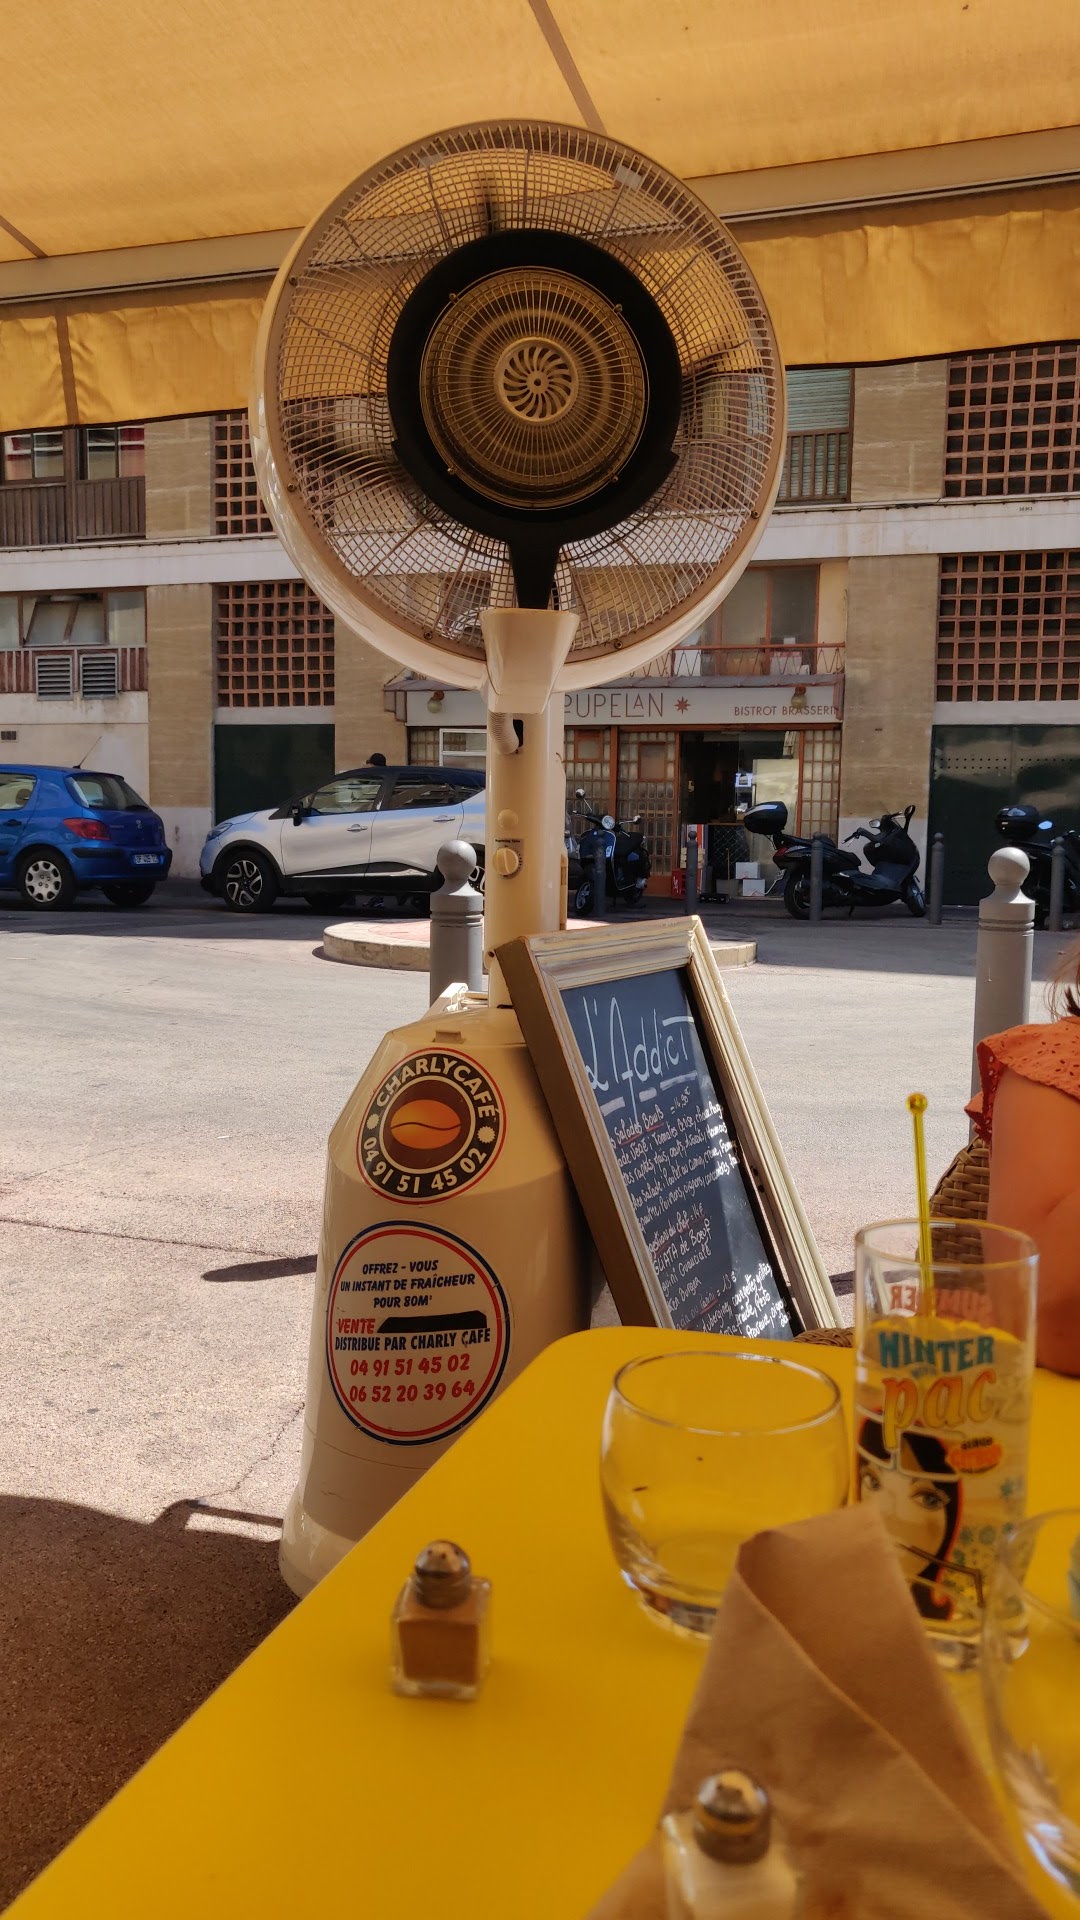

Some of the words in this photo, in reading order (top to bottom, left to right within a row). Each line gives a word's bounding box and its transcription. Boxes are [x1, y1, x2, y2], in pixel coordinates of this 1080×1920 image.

[734, 705, 777, 717] BISTROT
[781, 704, 840, 716] BRASSERI
[363, 1136, 380, 1162] 04
[372, 1161, 394, 1185] 91
[396, 1175, 420, 1194] 51
[431, 1168, 458, 1191] 45
[459, 1147, 487, 1174] 02
[362, 1262, 399, 1275] OFFREZ
[409, 1260, 439, 1273] VOUS
[340, 1281, 351, 1291] UN
[352, 1280, 392, 1292] INSTANT
[393, 1279, 407, 1290] DE
[410, 1273, 475, 1290] FRAÎCHEUR
[373, 1297, 401, 1308] POUR
[337, 1318, 376, 1334] VENTE
[335, 1336, 380, 1351] DISTRIBUE
[384, 1336, 407, 1351] PAR
[410, 1332, 457, 1349] CHARLY
[878, 1331, 995, 1373] WINTER
[350, 1359, 368, 1376] 04
[373, 1359, 390, 1377] 91
[394, 1358, 413, 1376] 51
[418, 1356, 442, 1374] 45
[447, 1353, 471, 1372] 02
[349, 1385, 367, 1402] 06
[371, 1385, 392, 1402] 52
[396, 1384, 418, 1402] 20
[423, 1382, 447, 1401] 39
[451, 1379, 475, 1398] 64
[881, 1367, 997, 1450] pac
